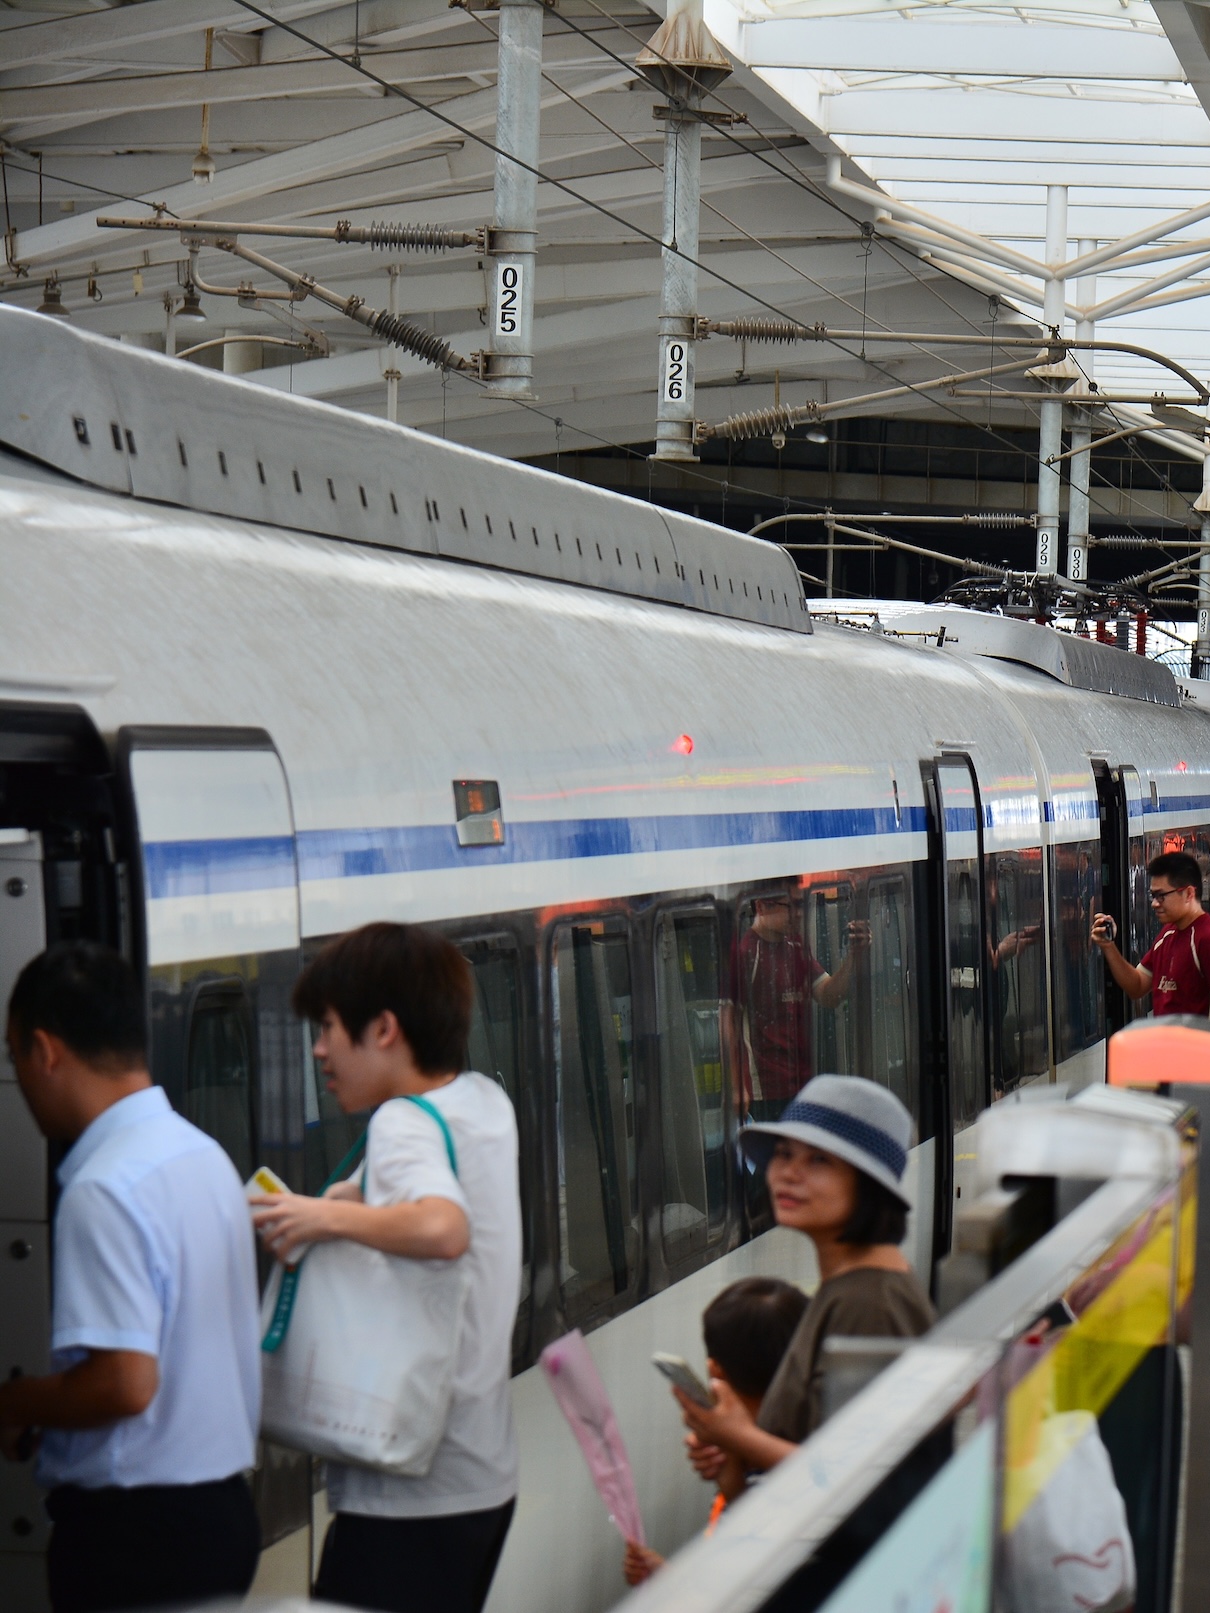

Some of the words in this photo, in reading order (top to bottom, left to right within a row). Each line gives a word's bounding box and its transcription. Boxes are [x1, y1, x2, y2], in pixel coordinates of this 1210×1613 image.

[500, 267, 518, 332] 025
[668, 344, 684, 399] 026
[1040, 533, 1049, 565] 029
[1072, 549, 1081, 579] 030
